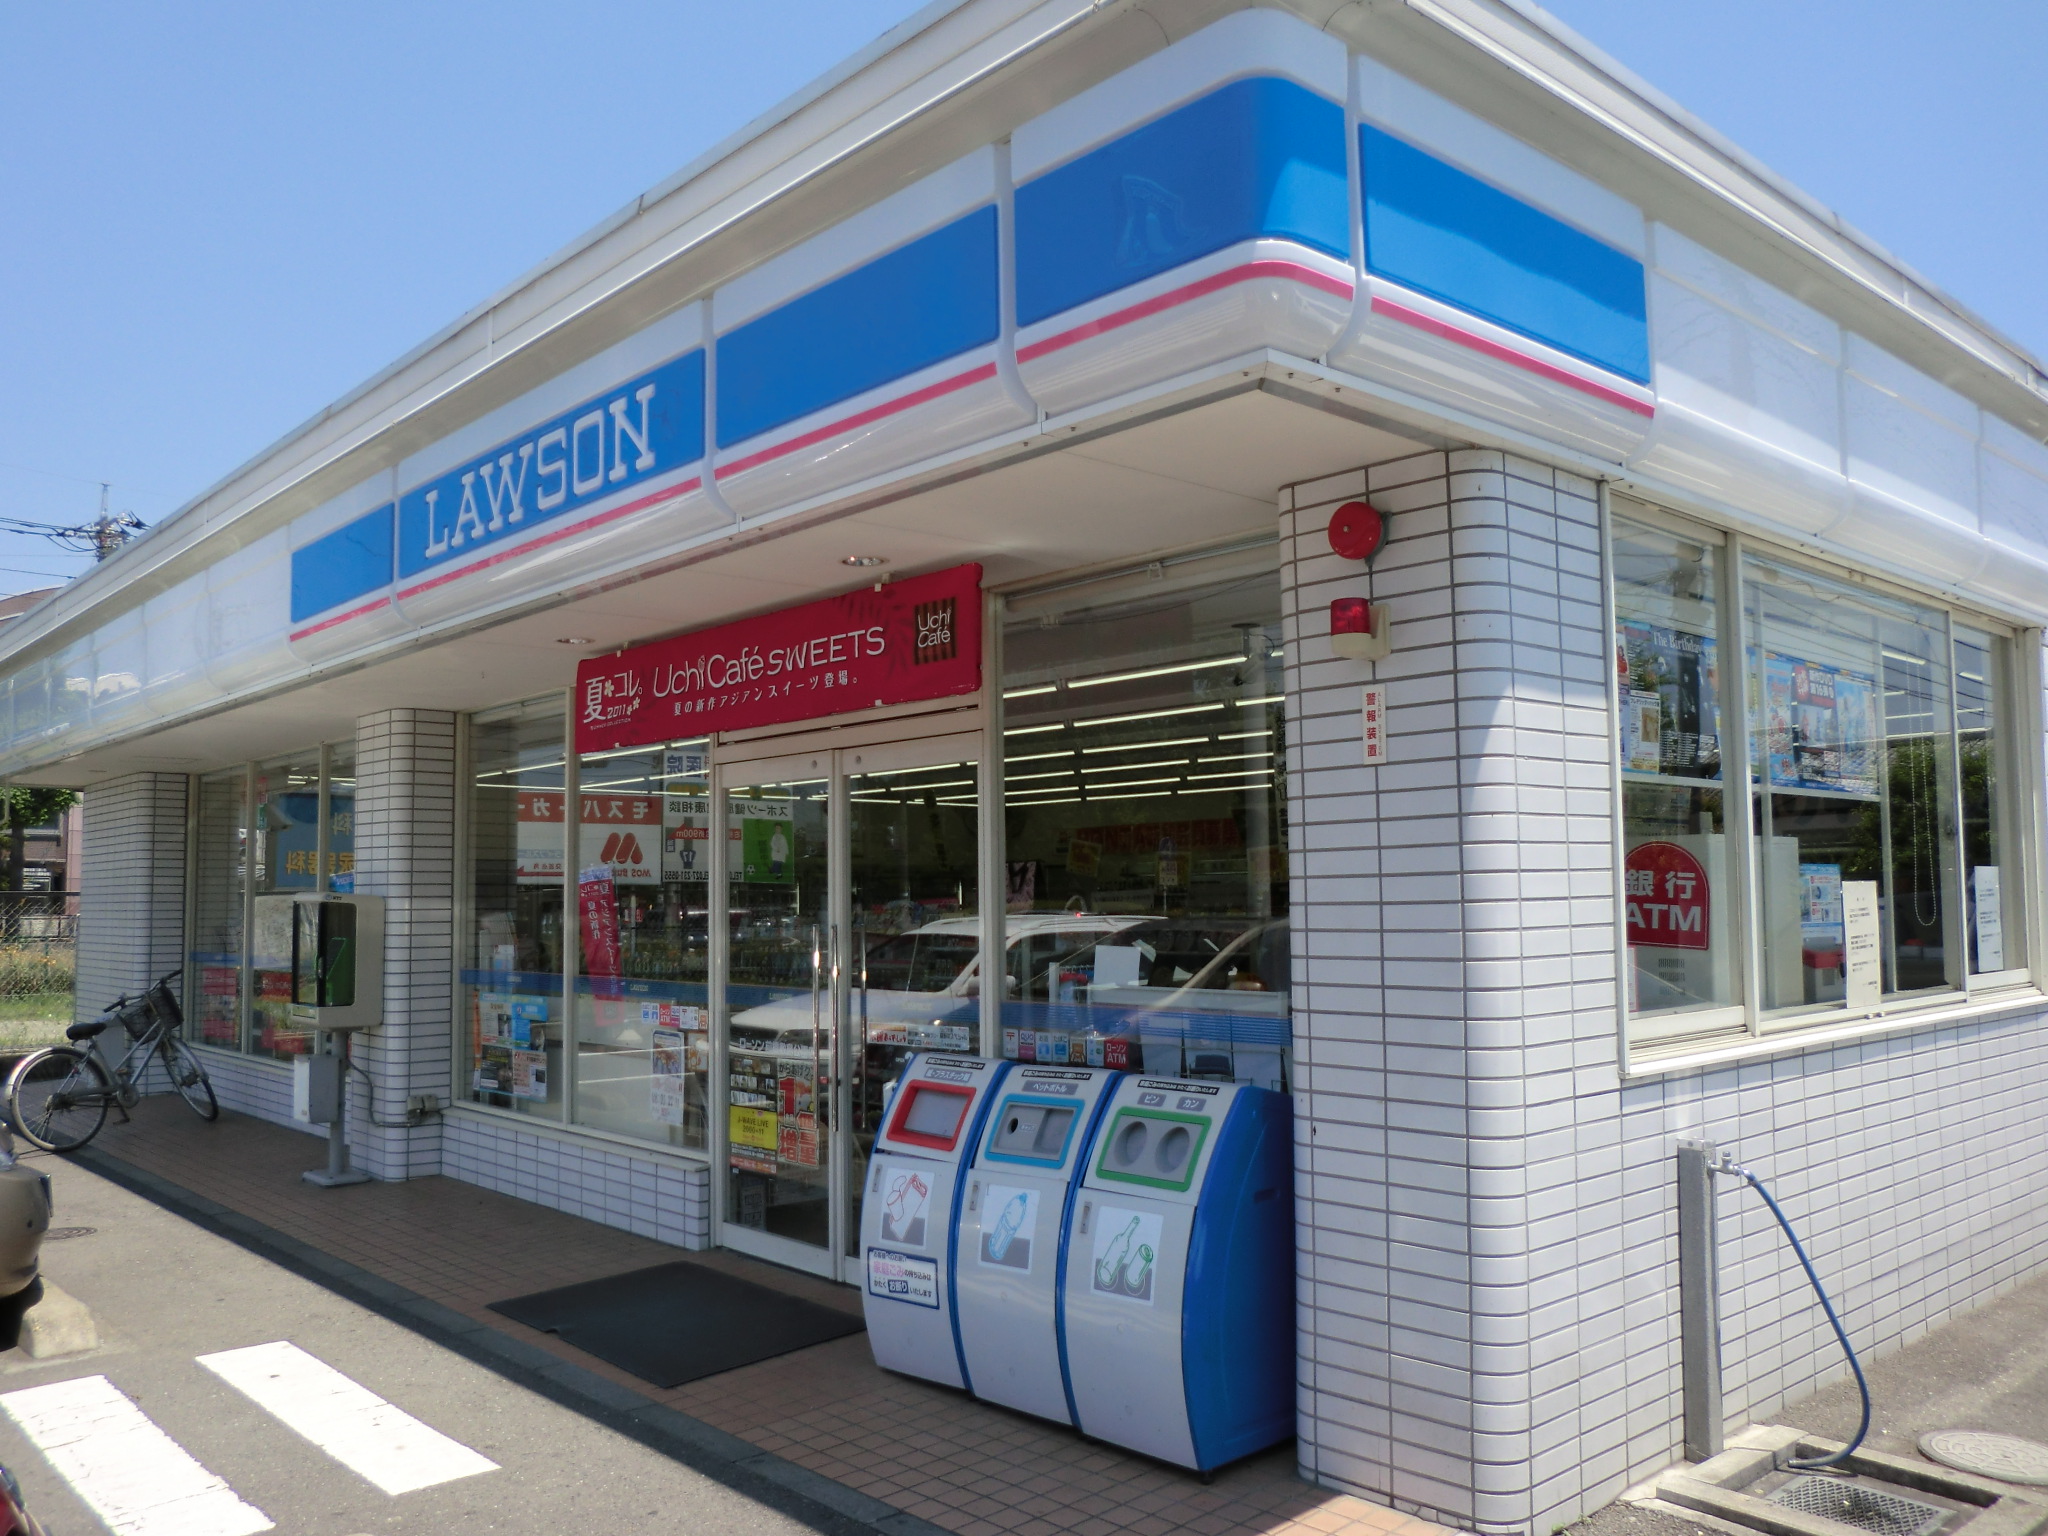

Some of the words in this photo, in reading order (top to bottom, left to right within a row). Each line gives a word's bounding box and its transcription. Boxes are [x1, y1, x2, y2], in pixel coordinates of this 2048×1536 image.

[425, 383, 655, 559] LAWSON
[917, 607, 952, 631] Uchi
[917, 628, 951, 649] Café
[1653, 631, 1668, 647] The
[766, 626, 886, 676] SWEETS
[674, 670, 858, 717] 夏の新作アジアンスイーツ登場。
[607, 704, 627, 720] 2011
[1625, 869, 1696, 899] 銀行
[1626, 902, 1701, 932] ATM
[1106, 1043, 1127, 1053] ローソン
[1107, 1052, 1127, 1064] ATM
[1033, 1083, 1067, 1093] ペットボトル
[1182, 1099, 1199, 1108] カン
